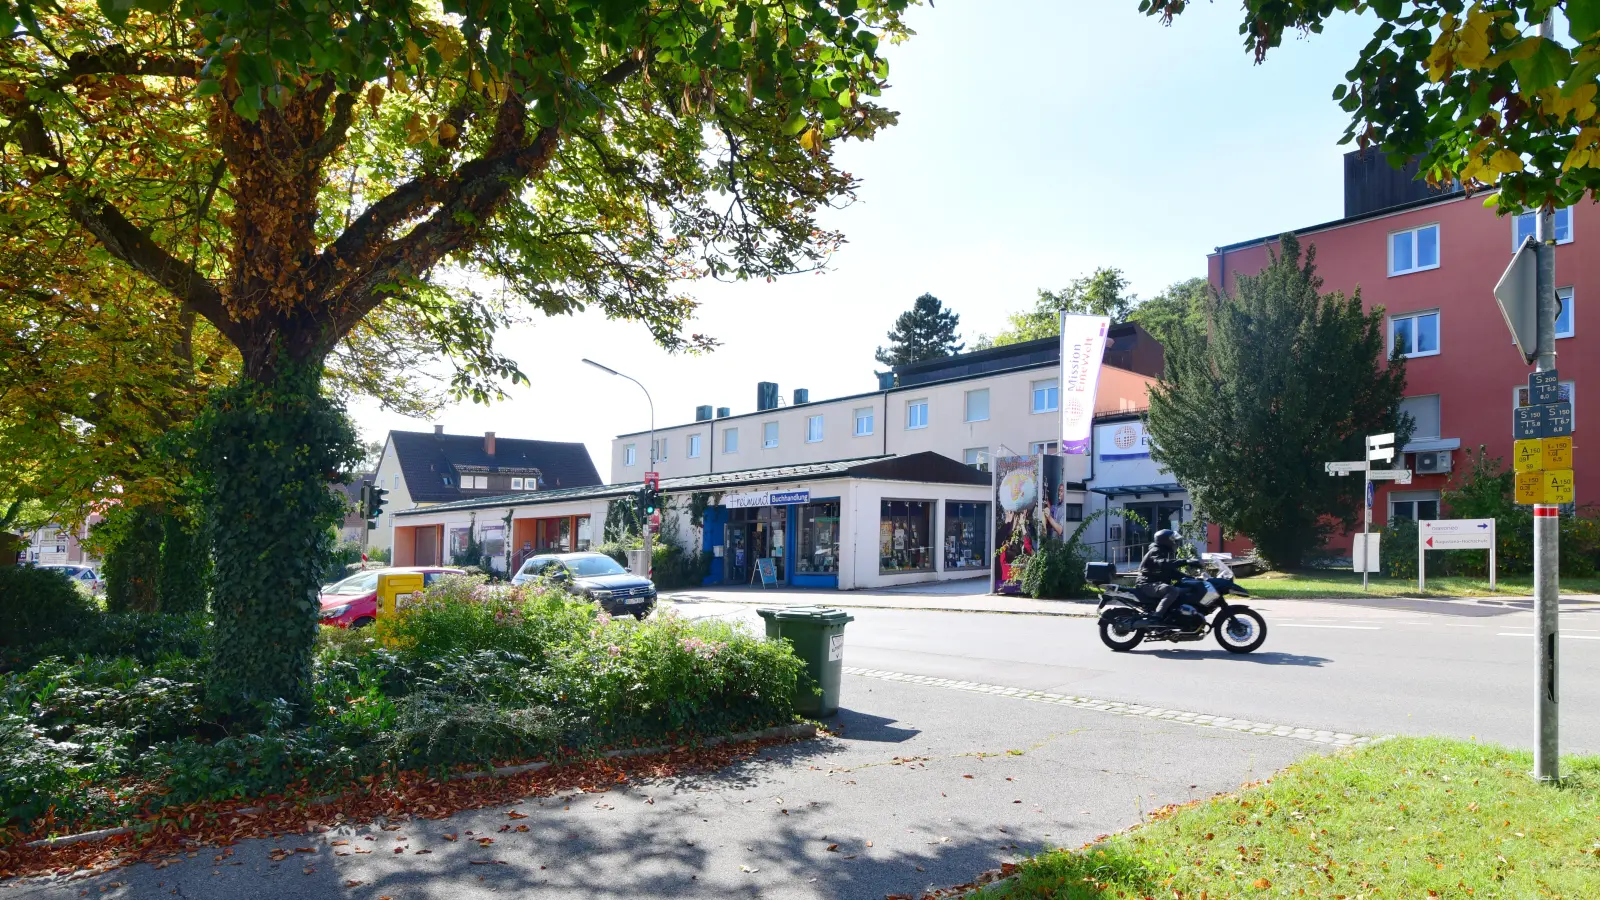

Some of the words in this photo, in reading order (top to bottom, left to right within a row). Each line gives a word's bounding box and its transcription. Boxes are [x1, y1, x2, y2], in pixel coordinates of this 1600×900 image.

[1067, 344, 1082, 392] Mission
[1521, 446, 1529, 454] A
[1551, 477, 1559, 485] A
[771, 492, 809, 503] Buchhandlung
